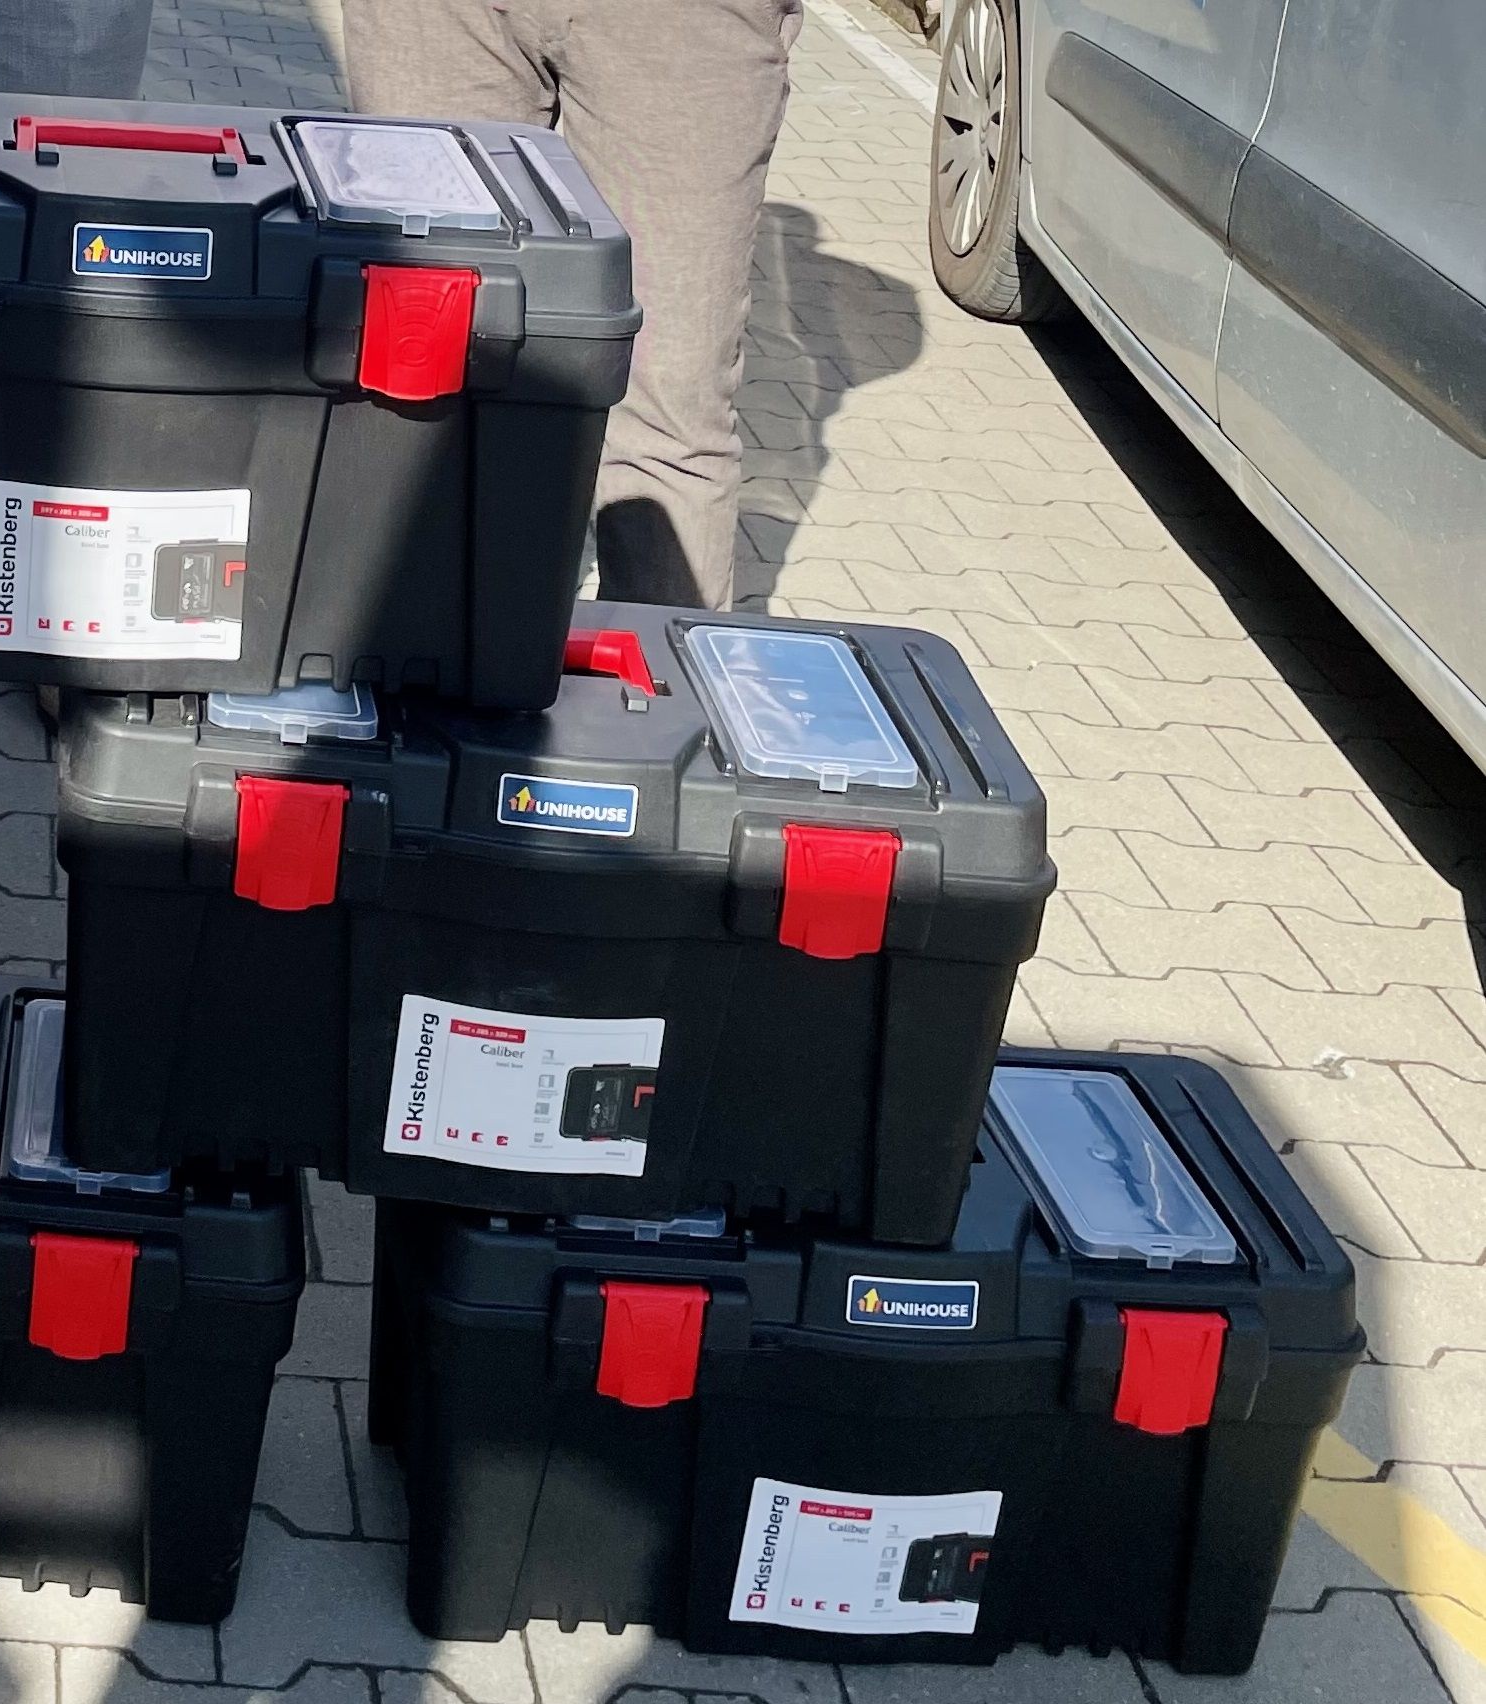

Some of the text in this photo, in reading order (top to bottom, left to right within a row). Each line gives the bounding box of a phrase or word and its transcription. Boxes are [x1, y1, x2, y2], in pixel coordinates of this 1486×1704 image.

[109, 249, 203, 267] UNIHOUSE
[65, 524, 111, 538] Caliber
[535, 800, 628, 823] UNIHOUSE
[480, 1043, 526, 1059] Caliber
[406, 1013, 440, 1122] Kistenberg
[882, 1300, 969, 1318] UNIHOUSE
[752, 1494, 790, 1592] Kistenberg
